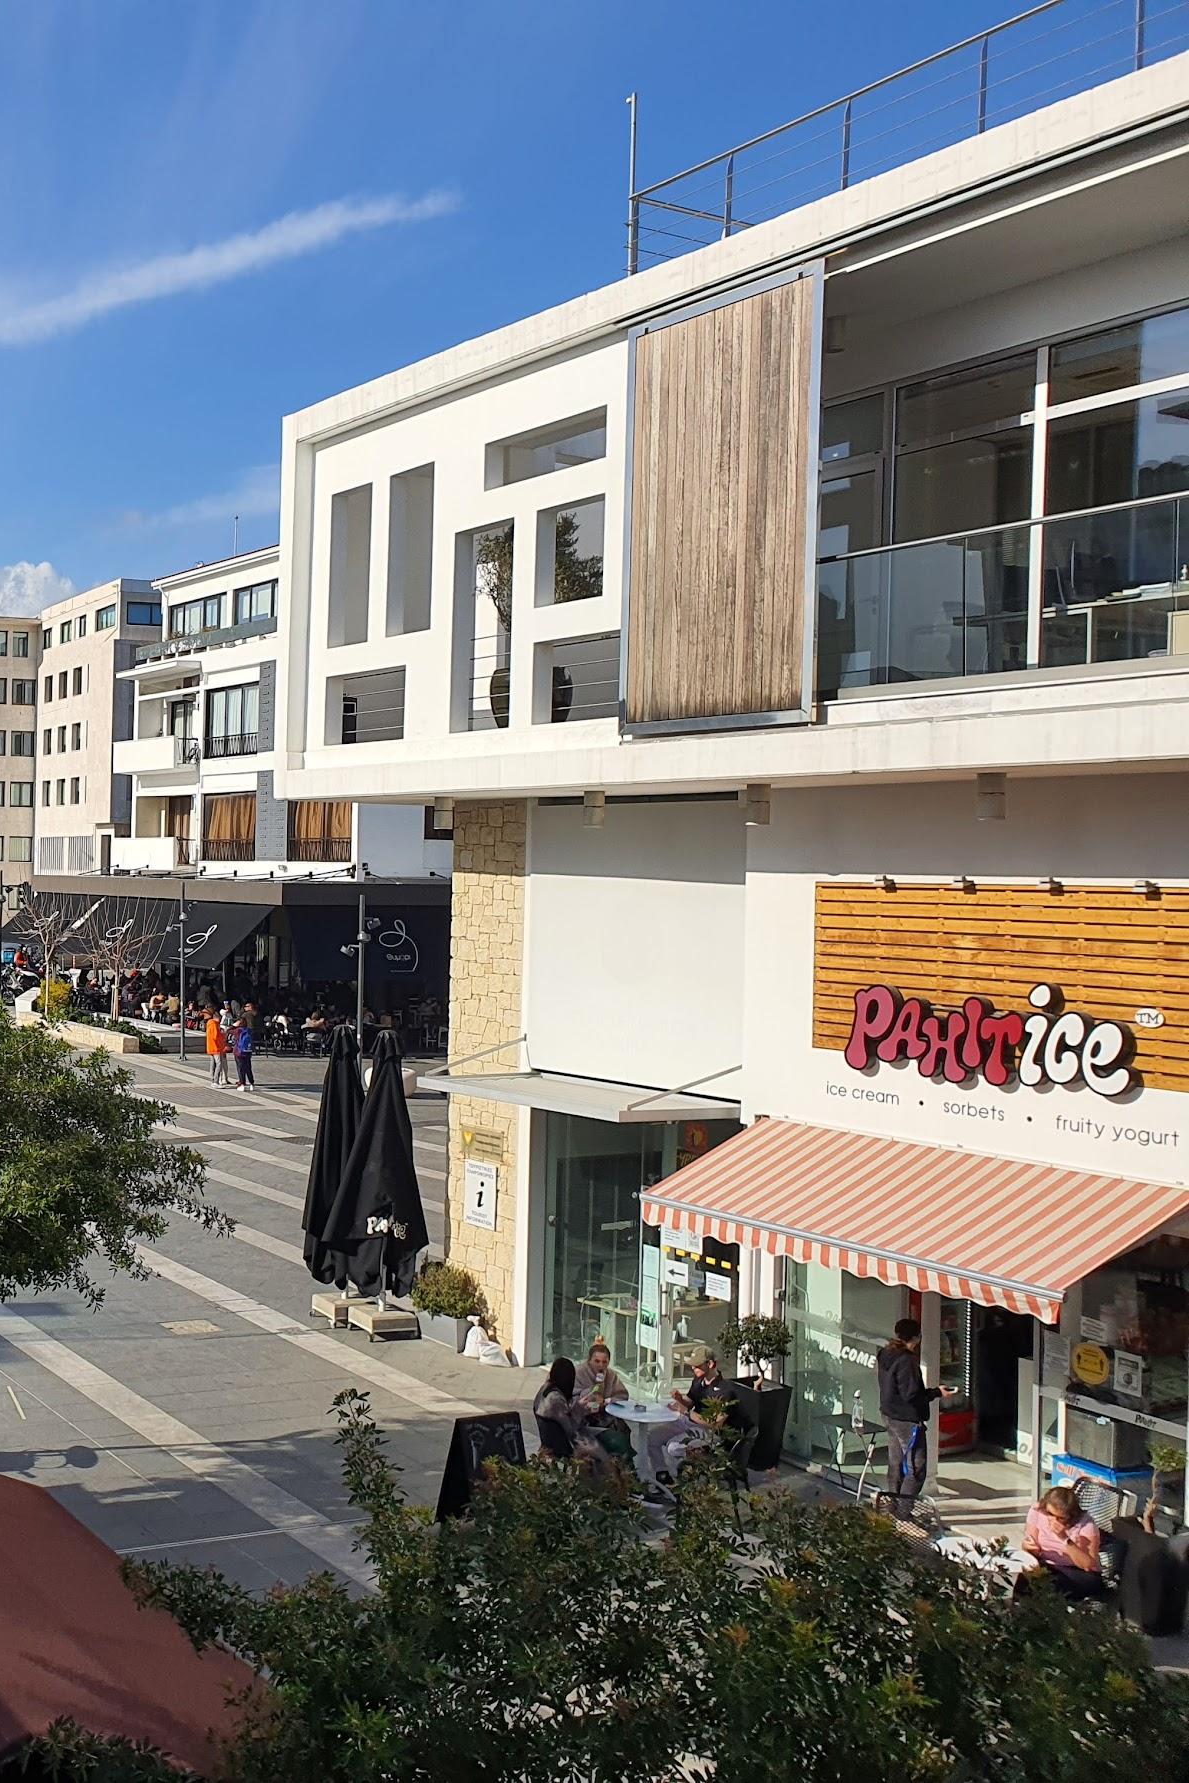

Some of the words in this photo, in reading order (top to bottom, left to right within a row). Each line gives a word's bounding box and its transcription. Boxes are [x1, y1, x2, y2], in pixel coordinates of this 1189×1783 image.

[1136, 1011, 1160, 1025] TM
[825, 1081, 847, 1097] ice
[852, 1086, 900, 1105] cream
[943, 1101, 1005, 1122] sorbets
[1056, 1114, 1106, 1139] fruity
[1112, 1125, 1180, 1147] yogurt
